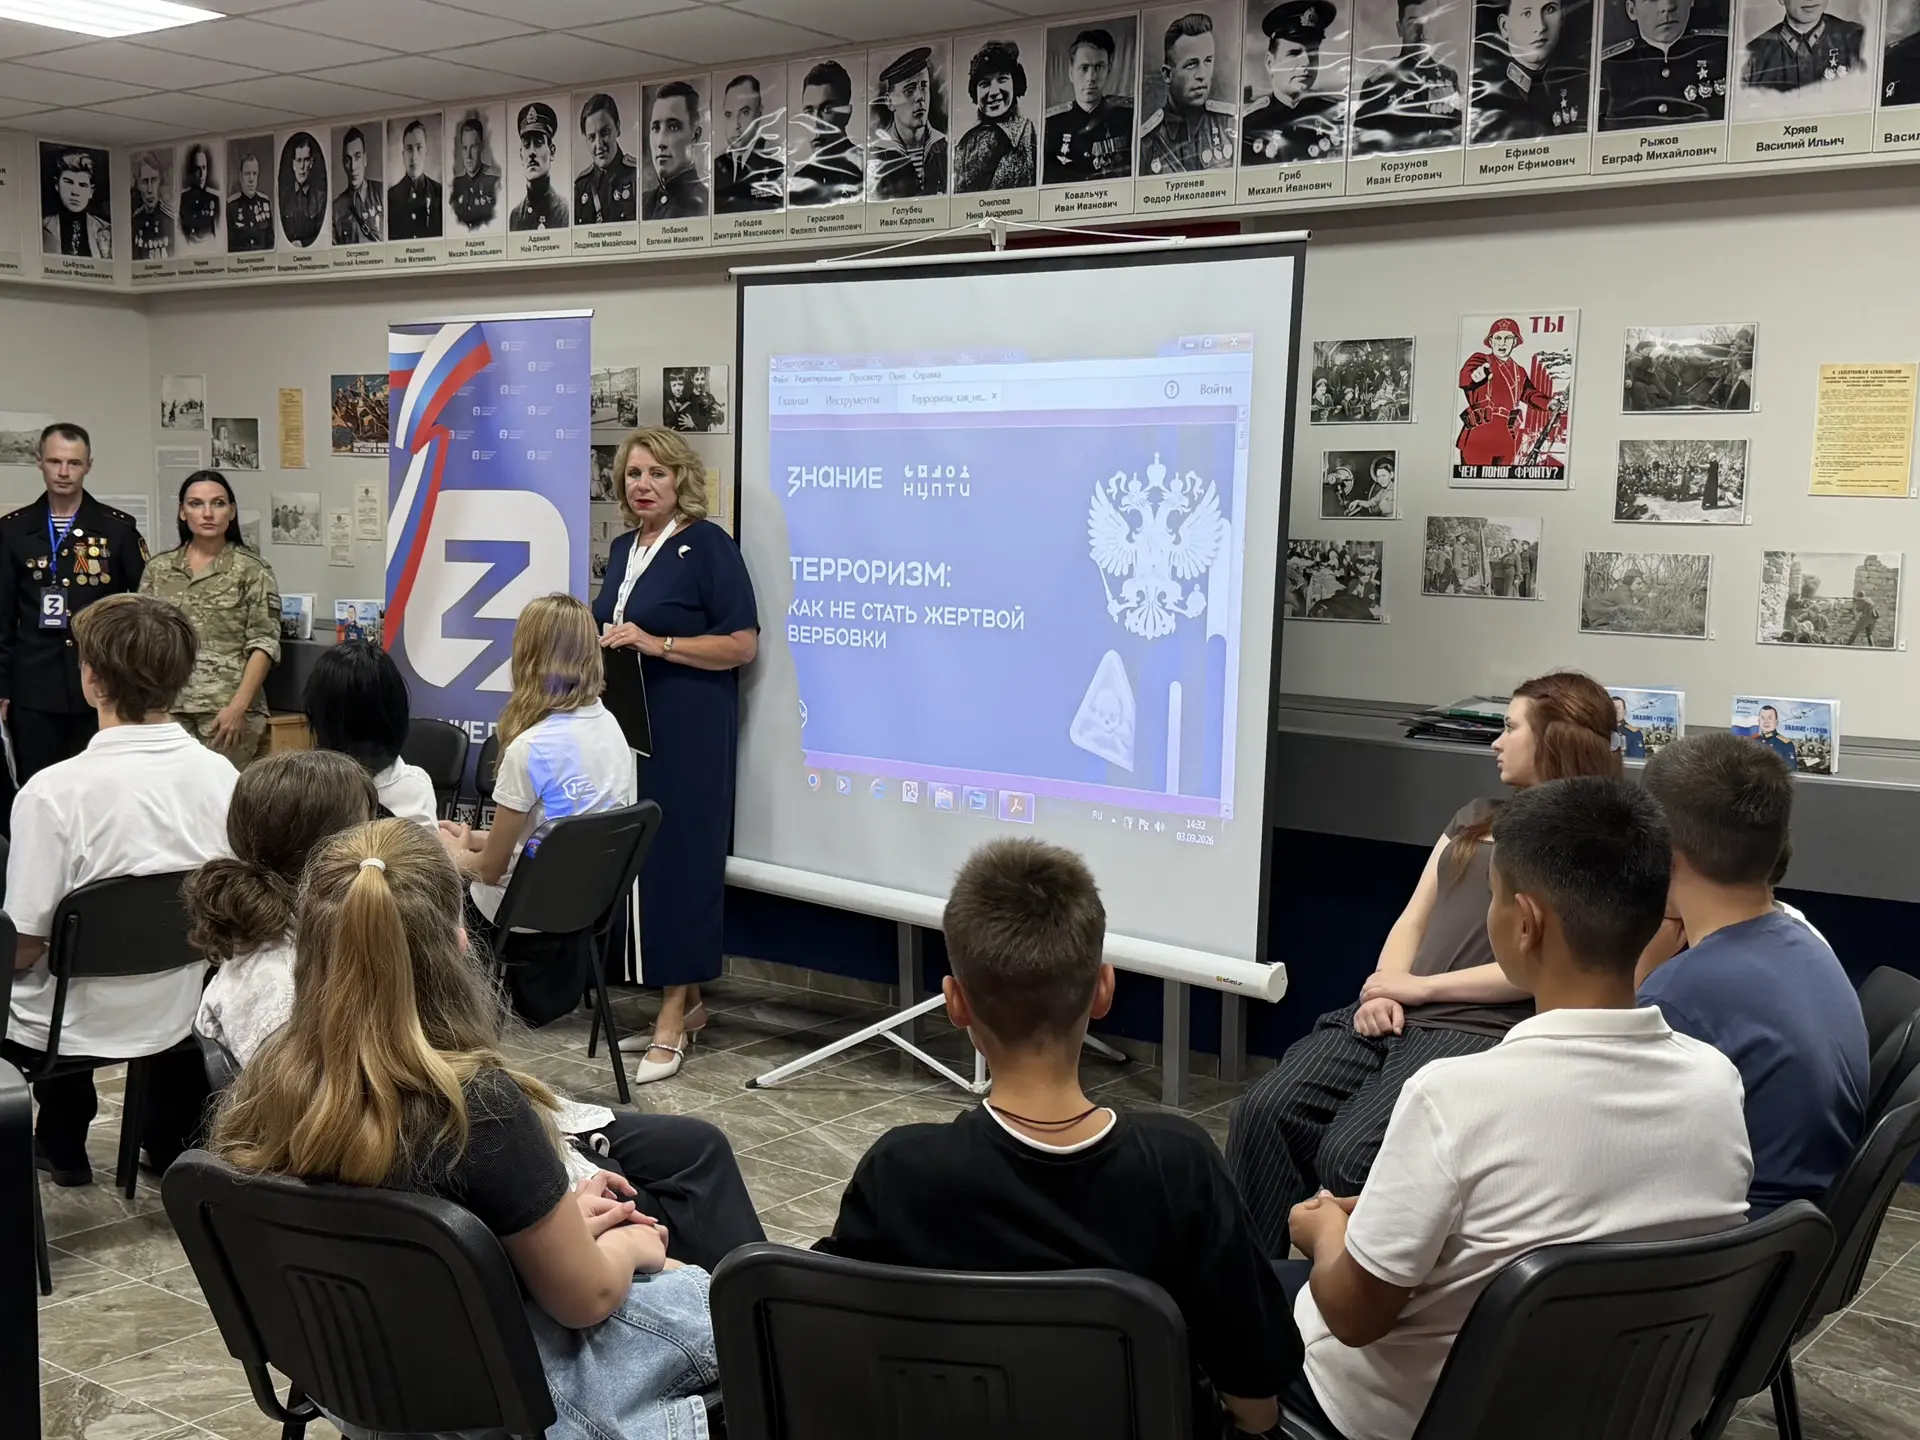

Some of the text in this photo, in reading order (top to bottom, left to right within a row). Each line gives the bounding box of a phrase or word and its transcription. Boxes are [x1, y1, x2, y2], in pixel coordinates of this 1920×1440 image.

[1783, 124, 1818, 136] Хряев
[1640, 136, 1679, 148] Рыжов
[1756, 136, 1844, 153] Василий Ильич
[1505, 146, 1550, 159] Ефимов
[1601, 146, 1717, 167] Евграф Михайлович
[1380, 159, 1429, 172] Корзунов
[1479, 156, 1575, 175] Мирон Ефимович
[1278, 170, 1302, 182] Гриб
[1366, 171, 1442, 186] Иван Егорович
[1165, 178, 1205, 191] Тургенев
[1247, 180, 1332, 197] Михаил Иванович
[1064, 189, 1108, 201] Ковальчук
[1143, 188, 1227, 206] Федор Николаевич
[979, 198, 1010, 208] Онилова
[1054, 200, 1118, 214] Иван Иванович
[892, 206, 923, 217] Голубец
[966, 208, 1023, 220] Нина Андреевна
[734, 219, 763, 228] Лебедев
[807, 213, 845, 224] Герасимов
[879, 216, 935, 228] Иван Карпович
[588, 230, 622, 239] Павличенко
[661, 226, 688, 235] Лобанов
[713, 228, 784, 242] Дмитрий Максимович
[790, 222, 862, 236] Филипп Филиппович
[574, 239, 637, 250] Людмила Михайловна
[646, 234, 704, 247] Евгений Иванович
[532, 244, 560, 253] Петрович
[1528, 315, 1565, 335] ТЫ
[912, 370, 942, 381] Справка
[778, 396, 810, 406] Главная
[825, 396, 880, 408] Инструменты
[1199, 384, 1232, 396] Войти
[1458, 465, 1560, 480] ЧЕМ ПОМОГ ФРОНТУ?
[789, 555, 952, 590] ТЕРРОРИЗМ:
[787, 598, 1025, 631] КАК НЕ СТАТЬ ЖЕРТВОЙ
[787, 624, 887, 650] ВЕРБОВКИ
[1092, 810, 1103, 820] RU
[1186, 818, 1206, 832] 14:32
[1176, 831, 1214, 846] 03.09.2026
